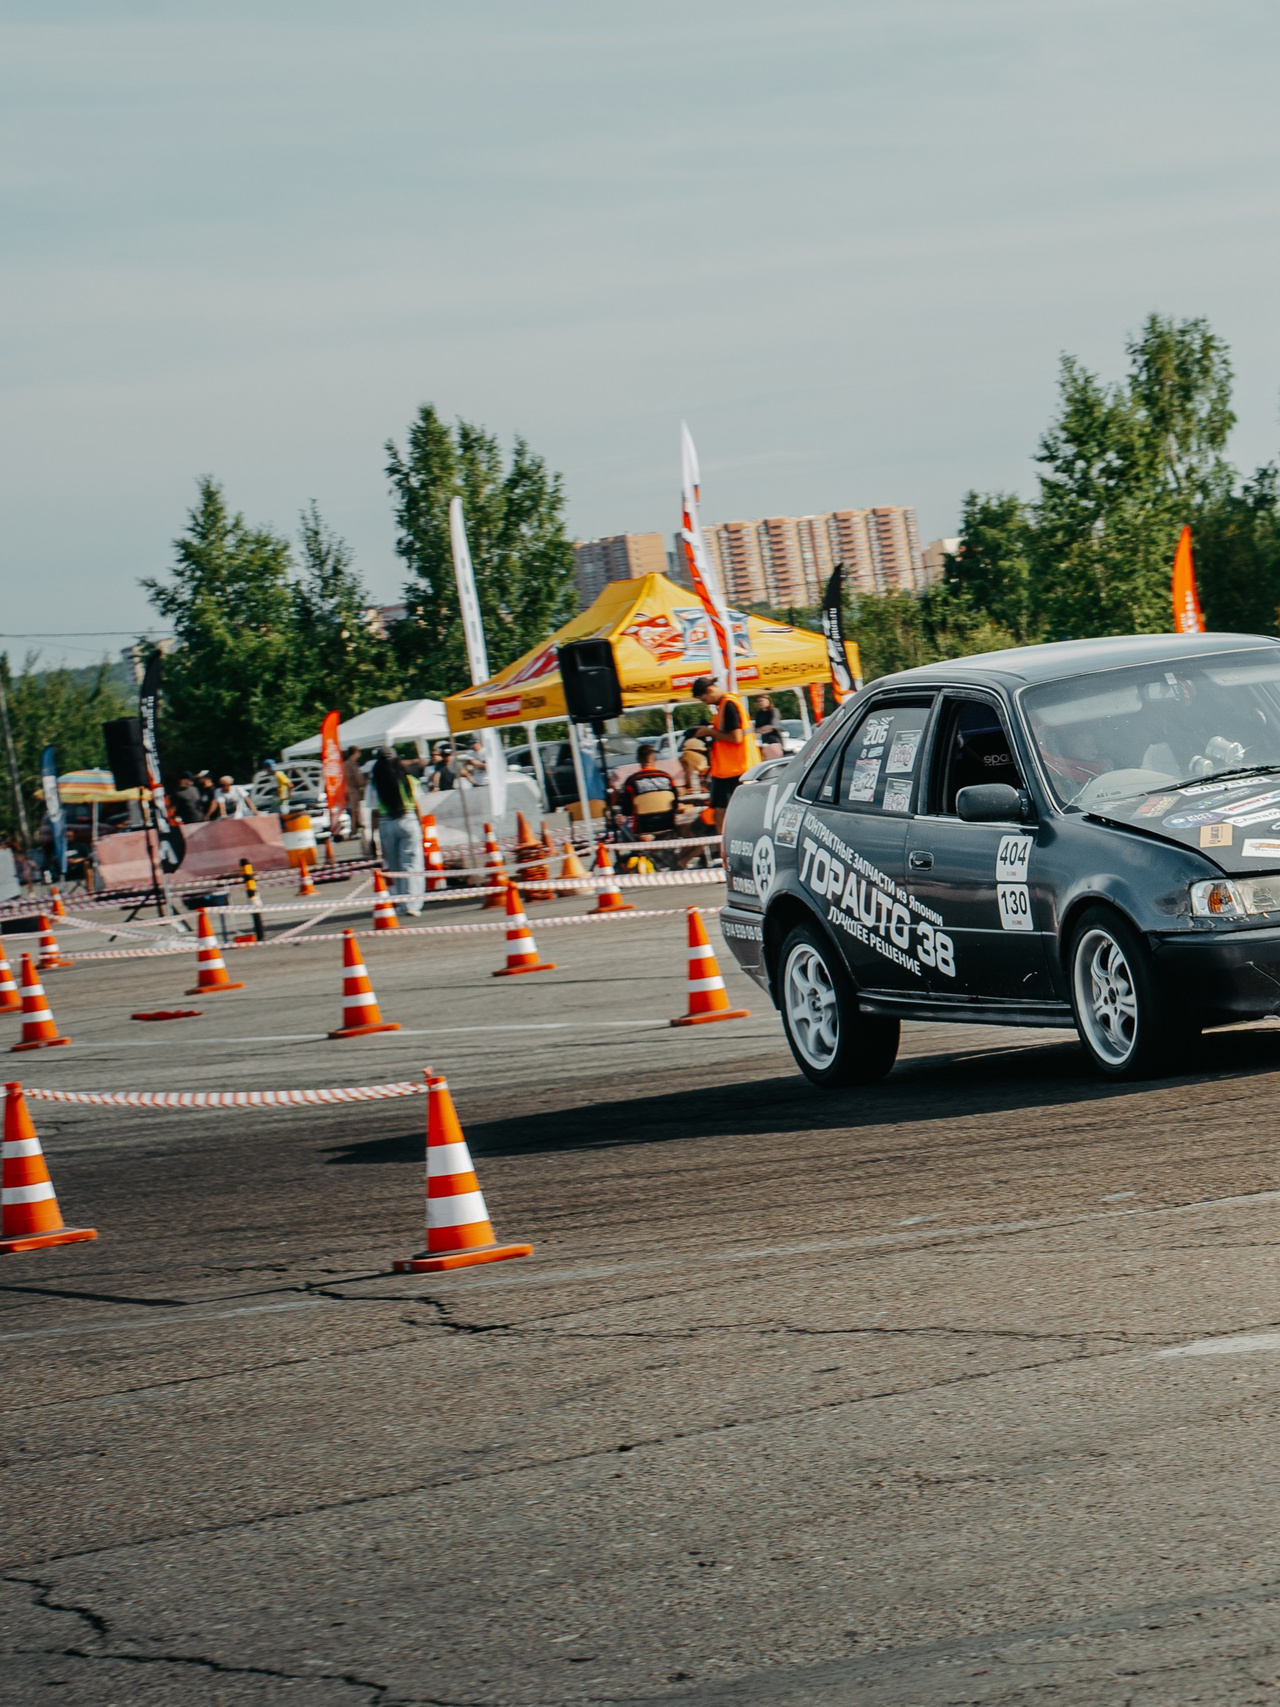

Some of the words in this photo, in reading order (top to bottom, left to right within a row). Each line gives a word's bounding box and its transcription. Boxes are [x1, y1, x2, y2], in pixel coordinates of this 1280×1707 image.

[803, 812, 853, 863] КОНТРАКТНЫЕ
[852, 853, 896, 896] ЗАПЧАСТИ
[999, 841, 1029, 866] 404
[799, 837, 911, 950] TOPAUTO
[916, 921, 956, 978] 38
[1000, 890, 1028, 915] 130
[827, 906, 869, 945] ЛУЧШЕЕ
[869, 933, 922, 977] РЕШЕНИЕ
